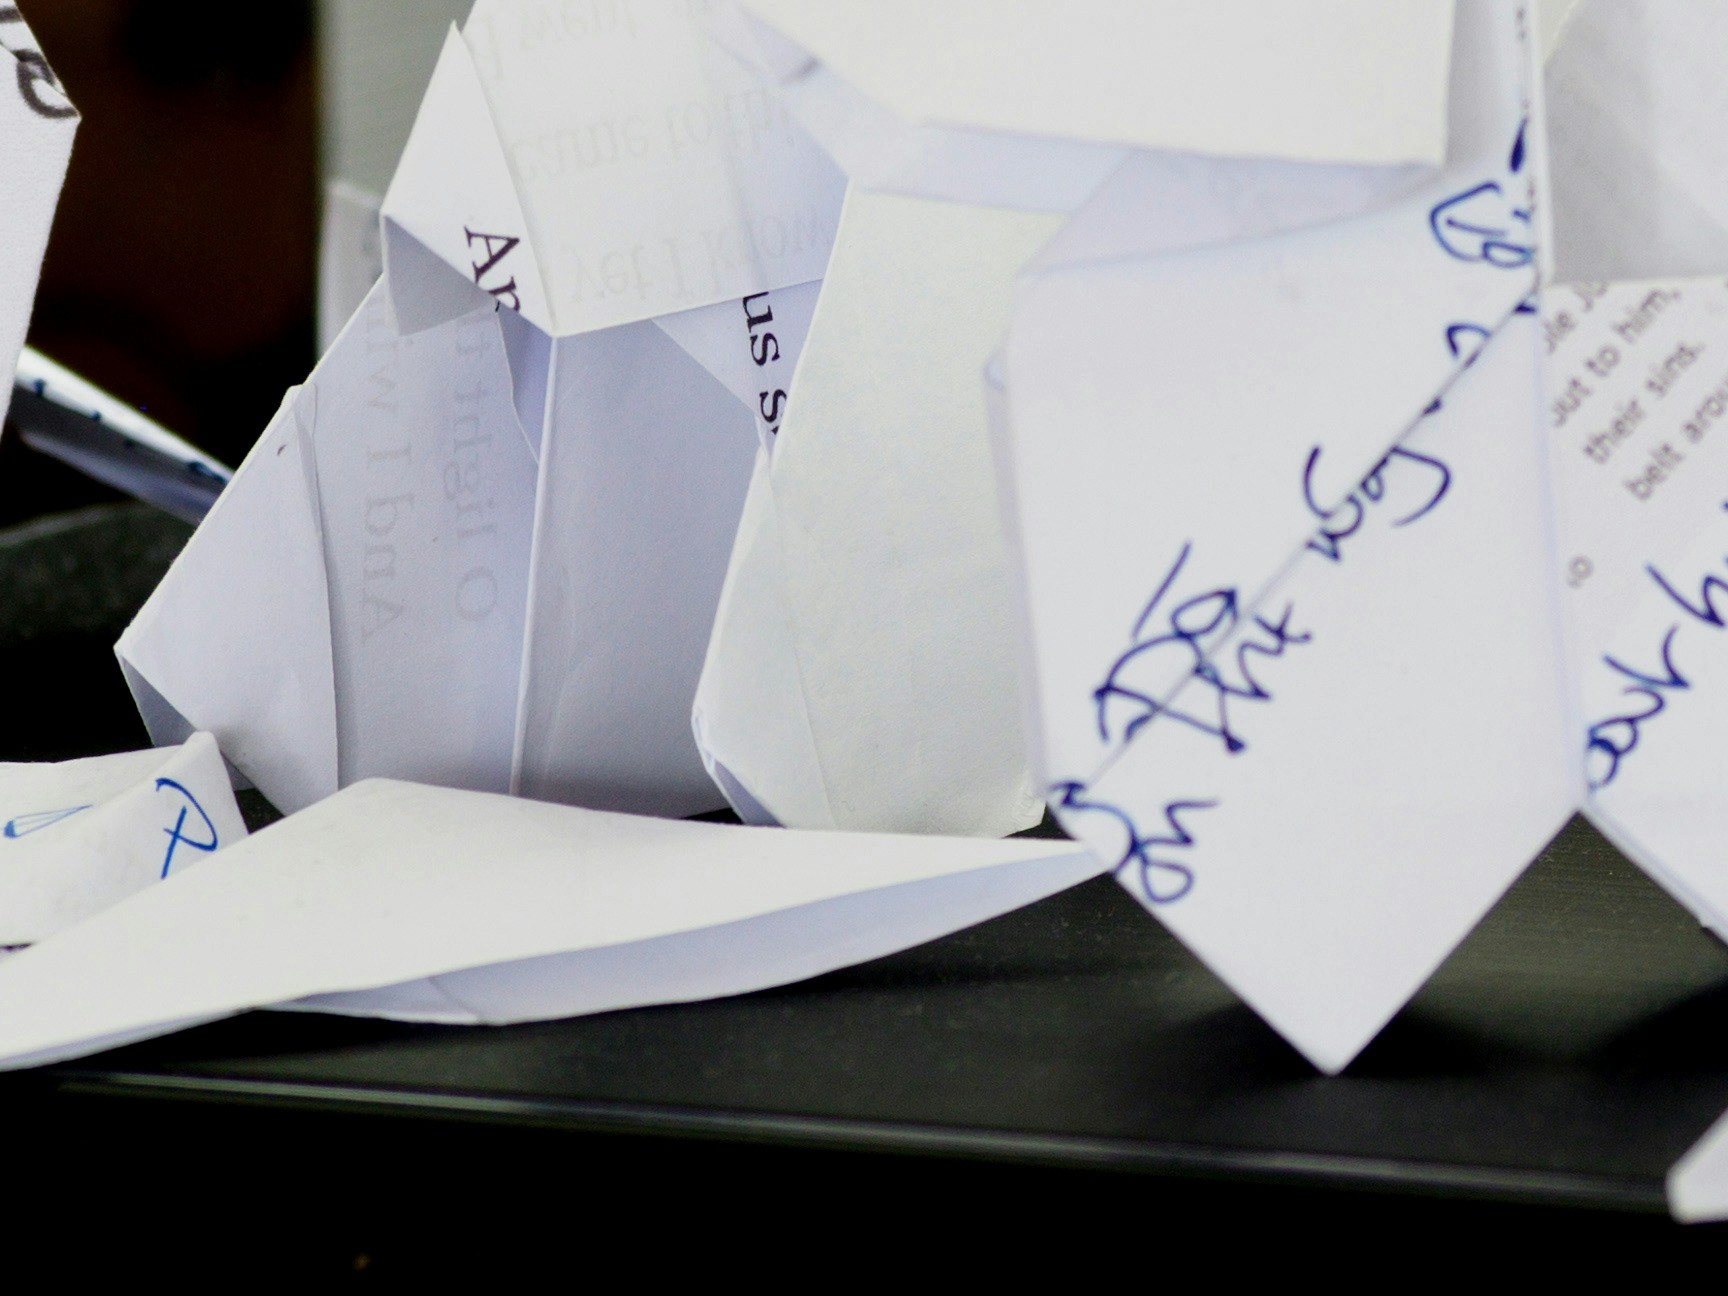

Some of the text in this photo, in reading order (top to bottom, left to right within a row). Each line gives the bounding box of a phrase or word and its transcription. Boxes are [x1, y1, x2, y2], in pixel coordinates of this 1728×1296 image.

[1584, 343, 1621, 378] to
[759, 388, 788, 437] s
[1582, 399, 1645, 465] their
[1624, 441, 1685, 502] belt
